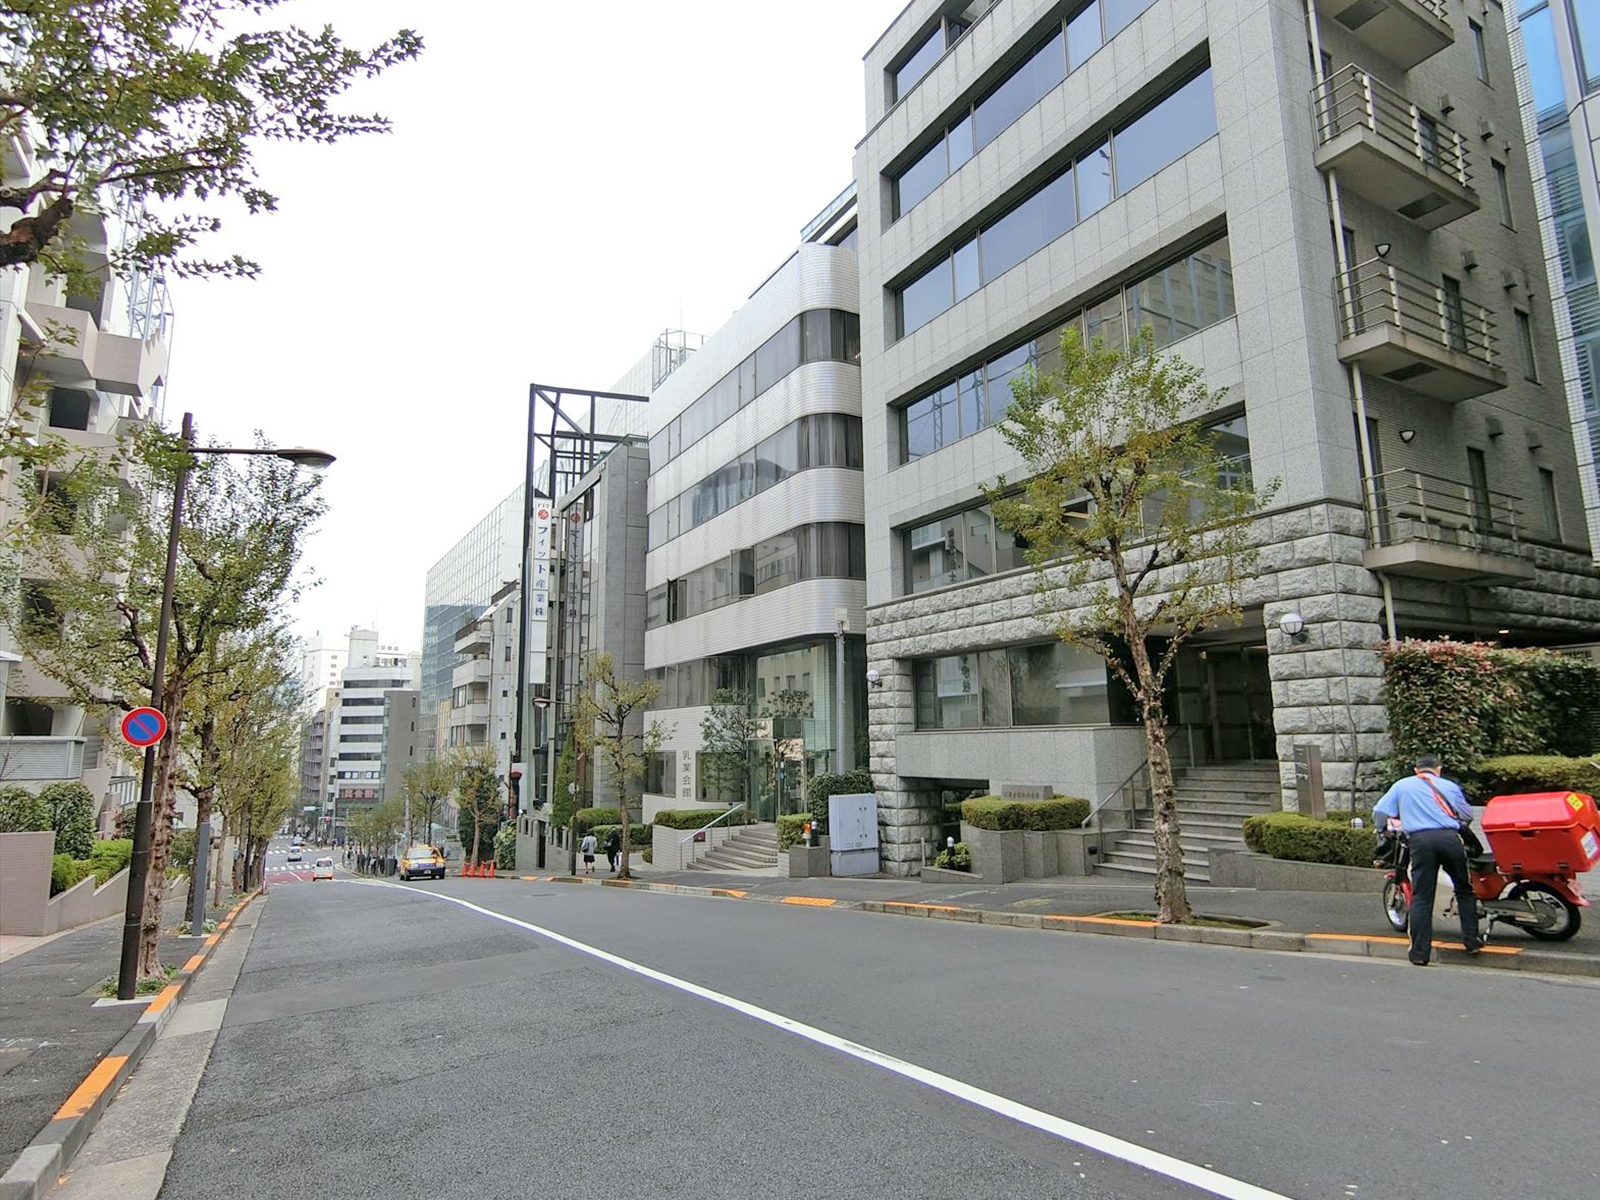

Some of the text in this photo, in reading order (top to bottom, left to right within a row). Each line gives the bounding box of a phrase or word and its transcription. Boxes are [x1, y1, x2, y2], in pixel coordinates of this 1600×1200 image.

[535, 526, 548, 617] フィット産業株
[682, 750, 692, 798] 乳業会館
